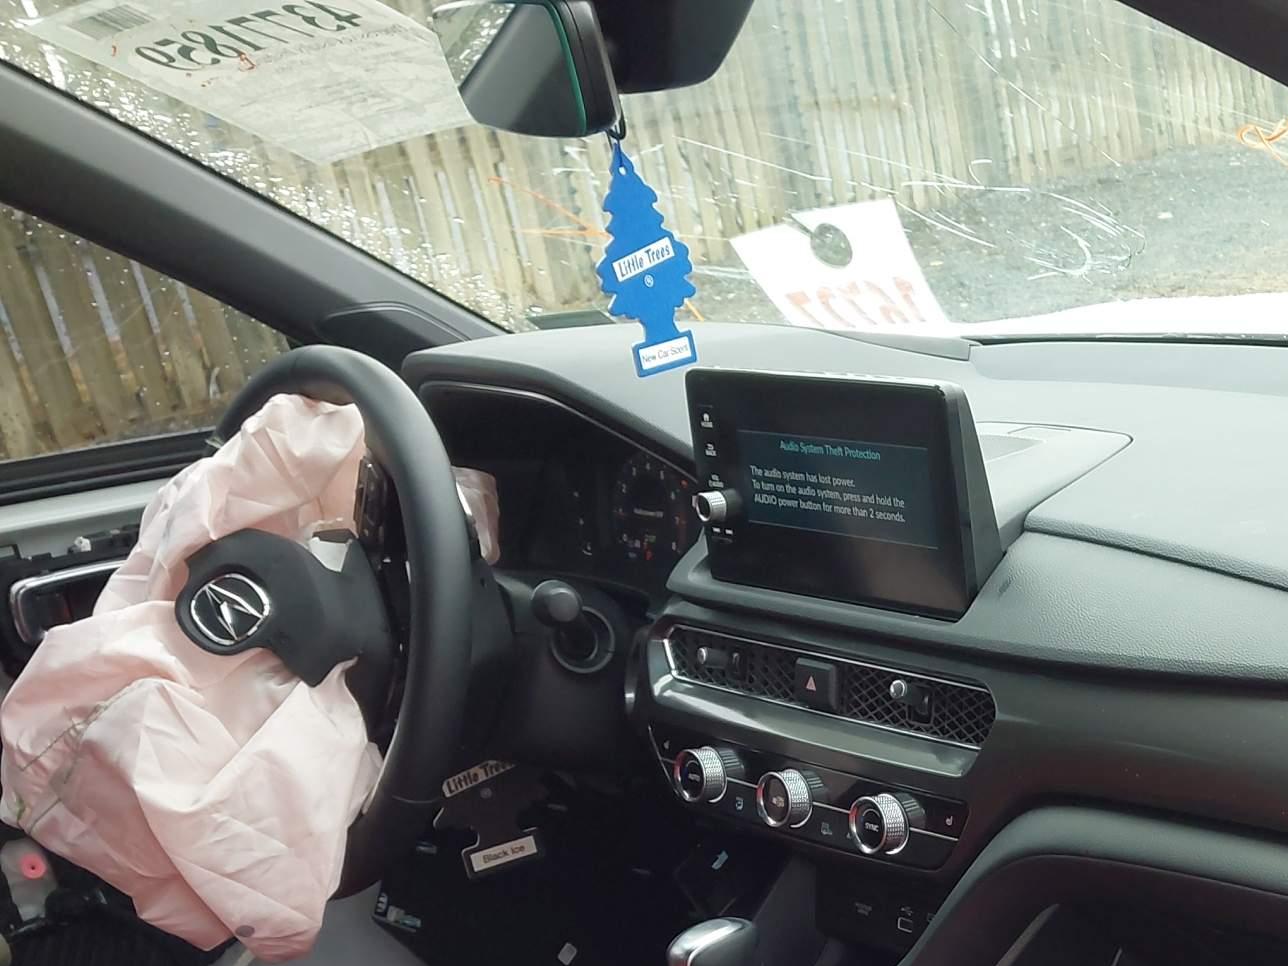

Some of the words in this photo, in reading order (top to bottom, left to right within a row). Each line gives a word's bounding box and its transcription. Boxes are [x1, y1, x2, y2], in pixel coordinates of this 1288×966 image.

[617, 254, 645, 278] Little
[645, 244, 671, 265] Trees
[642, 352, 656, 363] New
[657, 349, 669, 359] Car
[669, 344, 689, 356] Scent
[780, 440, 799, 452] Audio
[800, 442, 824, 454] System
[824, 444, 843, 456] Theft
[844, 446, 880, 460] Protection
[750, 465, 763, 476] The
[764, 468, 781, 479] audio
[783, 471, 805, 481] system
[806, 472, 818, 483] has
[818, 473, 831, 485] lost
[832, 477, 856, 488] power.
[752, 479, 761, 489] To
[761, 481, 775, 491] turn
[776, 484, 785, 492] on
[785, 484, 797, 494] the
[798, 486, 816, 496] audio
[843, 492, 861, 503] press
[862, 494, 875, 504] and
[876, 494, 892, 506] hold
[893, 497, 905, 508] the
[754, 493, 777, 505] AUDIO
[778, 498, 799, 507] power
[799, 499, 821, 511] button
[822, 501, 832, 512] for
[833, 505, 851, 515] more
[852, 506, 868, 517] than
[875, 511, 906, 523] seconds.
[446, 771, 480, 794] Little
[479, 761, 515, 778] Tree
[864, 822, 879, 832] SYNC
[483, 848, 509, 864] Black
[510, 845, 526, 856] Ice
